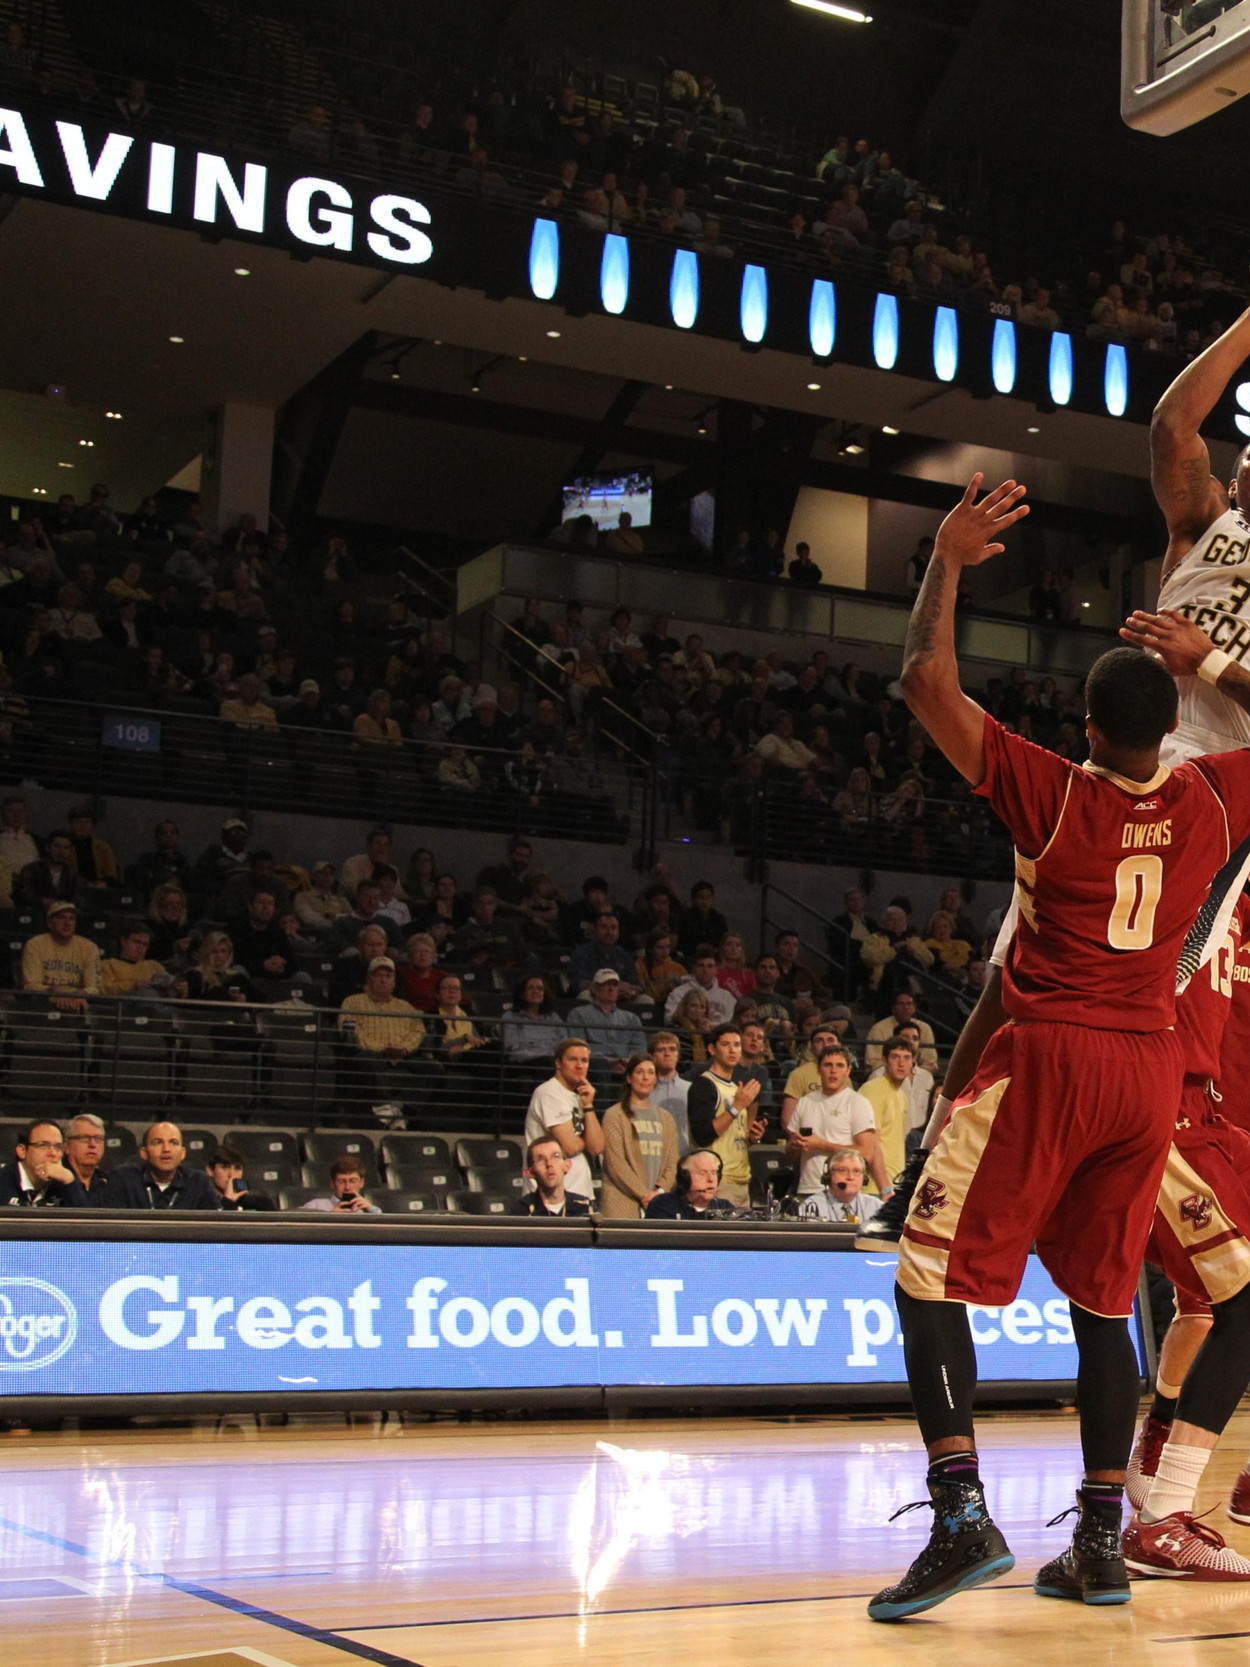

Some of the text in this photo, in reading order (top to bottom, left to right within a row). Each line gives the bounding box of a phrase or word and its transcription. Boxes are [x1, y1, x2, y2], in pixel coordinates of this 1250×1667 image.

[989, 301, 1012, 316] 209
[113, 724, 149, 743] 108
[1132, 800, 1158, 810] ACC
[1120, 818, 1172, 849] OWENS
[1107, 854, 1164, 950] 0
[99, 1276, 1077, 1367] Great food. Low pces
